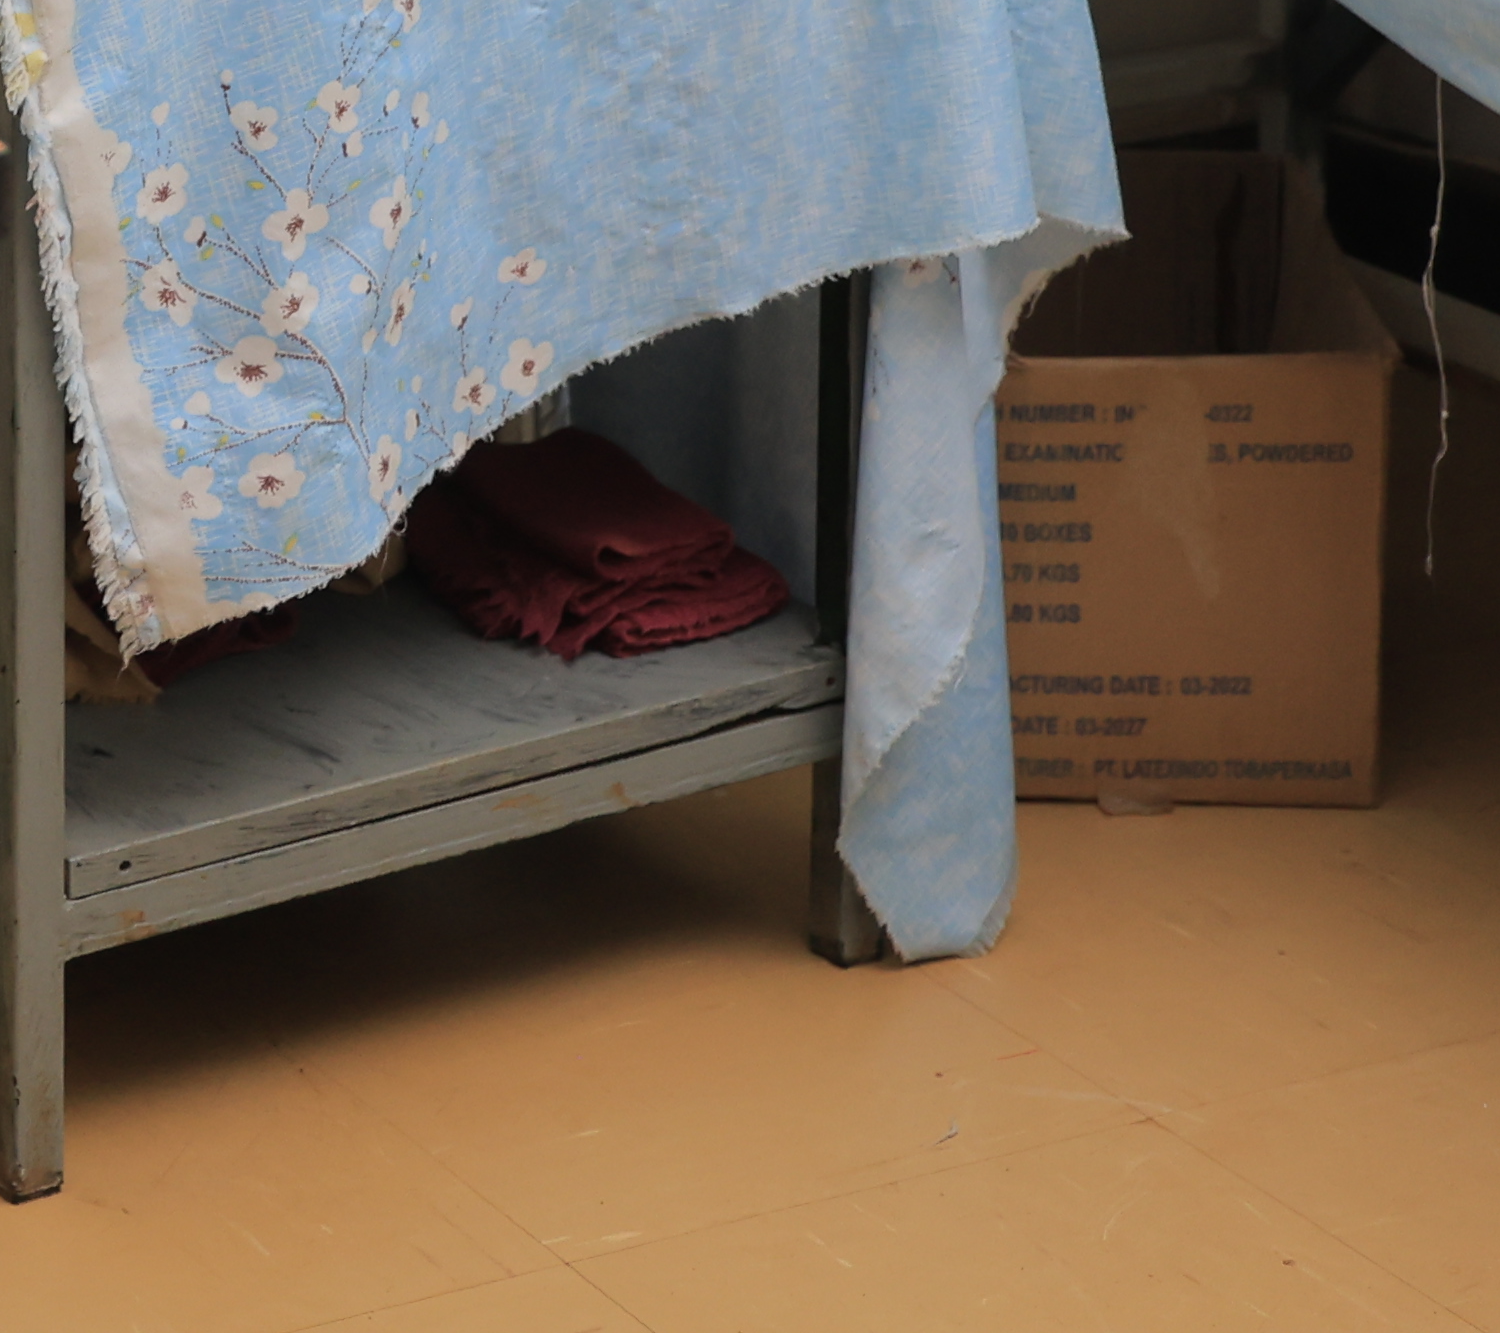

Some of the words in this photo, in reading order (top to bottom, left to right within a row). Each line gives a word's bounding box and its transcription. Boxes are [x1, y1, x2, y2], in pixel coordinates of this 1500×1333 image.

[1010, 404, 1096, 423] NUMBER
[1004, 443, 1124, 462] EXAMINATIO
[1238, 443, 1353, 463] POWDERED
[999, 484, 1076, 502] MEDIUM
[1024, 523, 1092, 542] BOXES
[1004, 563, 1033, 581] .70
[1038, 563, 1080, 582] KGS
[1006, 604, 1033, 623] .80
[1039, 604, 1081, 623] KGS
[1009, 675, 1104, 695] ACTURING
[1110, 675, 1160, 695] DATE
[1016, 758, 1074, 777] TURER
